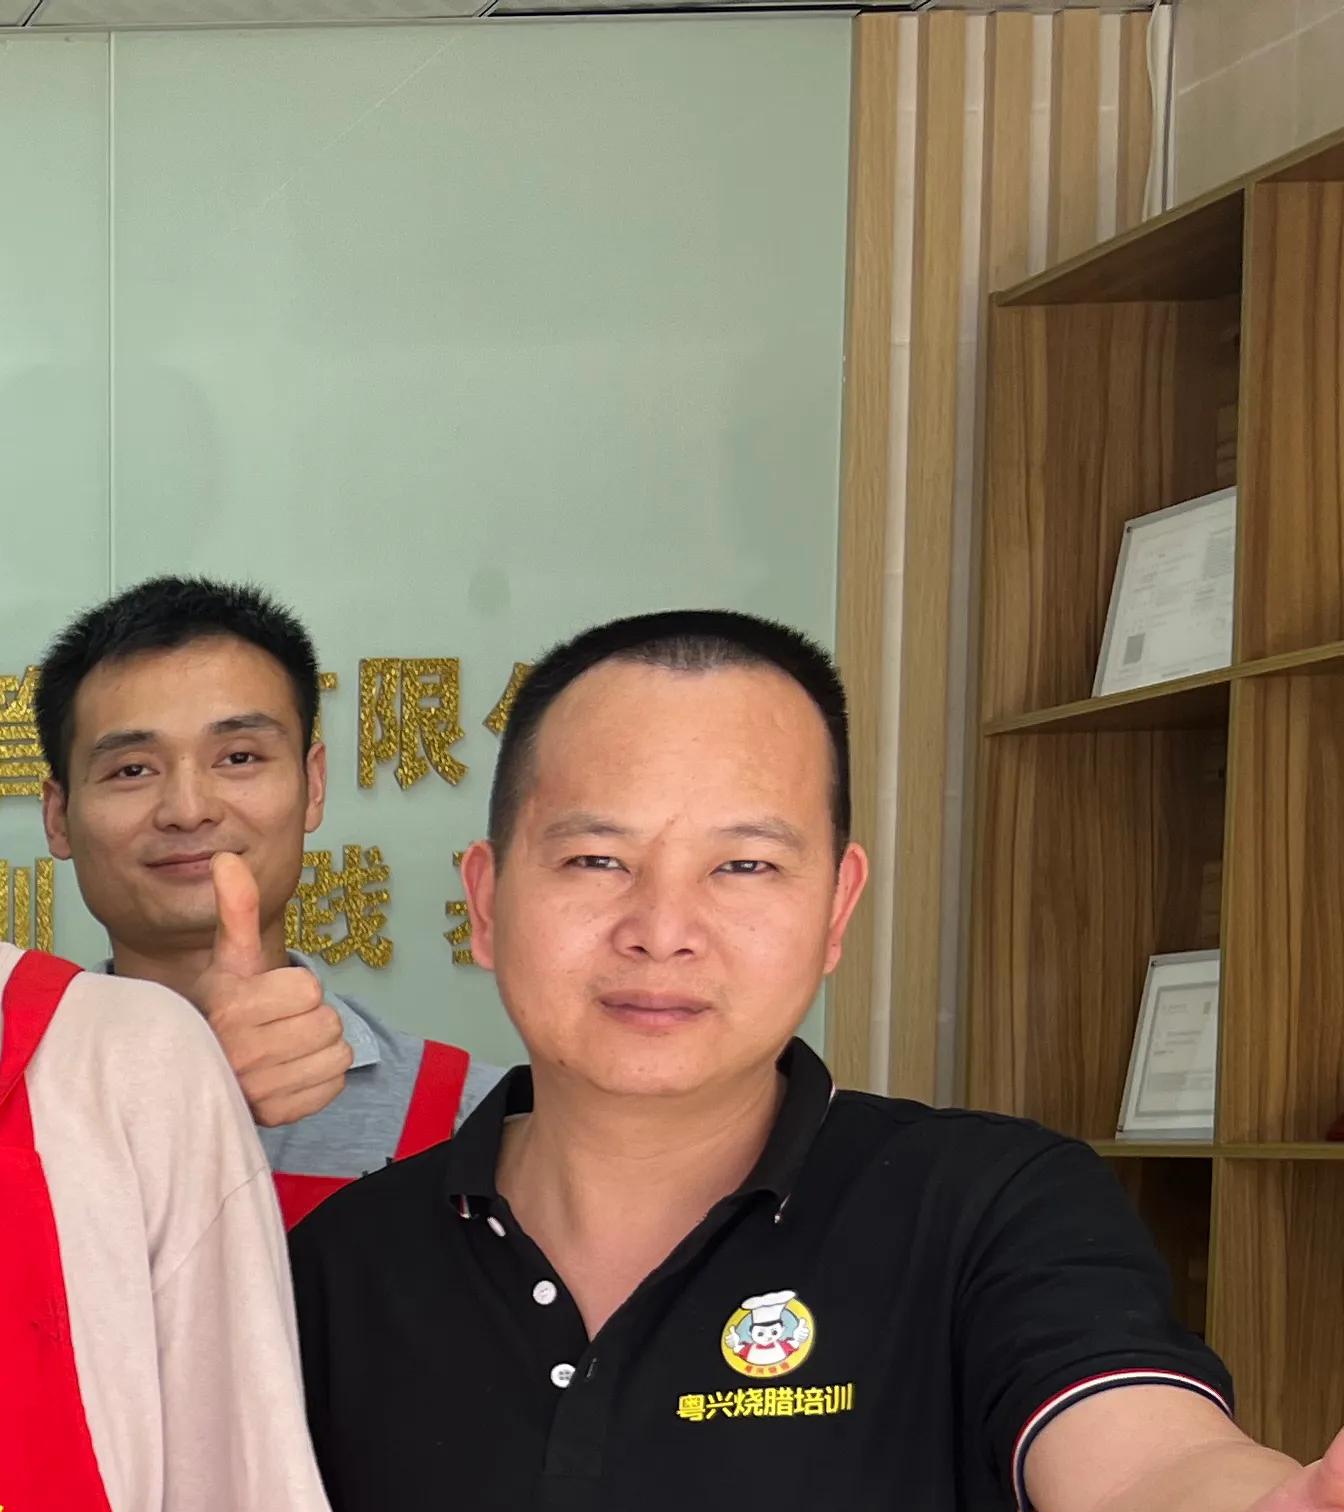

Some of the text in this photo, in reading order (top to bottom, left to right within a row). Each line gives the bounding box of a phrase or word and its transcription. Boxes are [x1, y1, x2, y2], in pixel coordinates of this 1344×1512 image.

[676, 1383, 853, 1422] 粤兴烧腊培训
